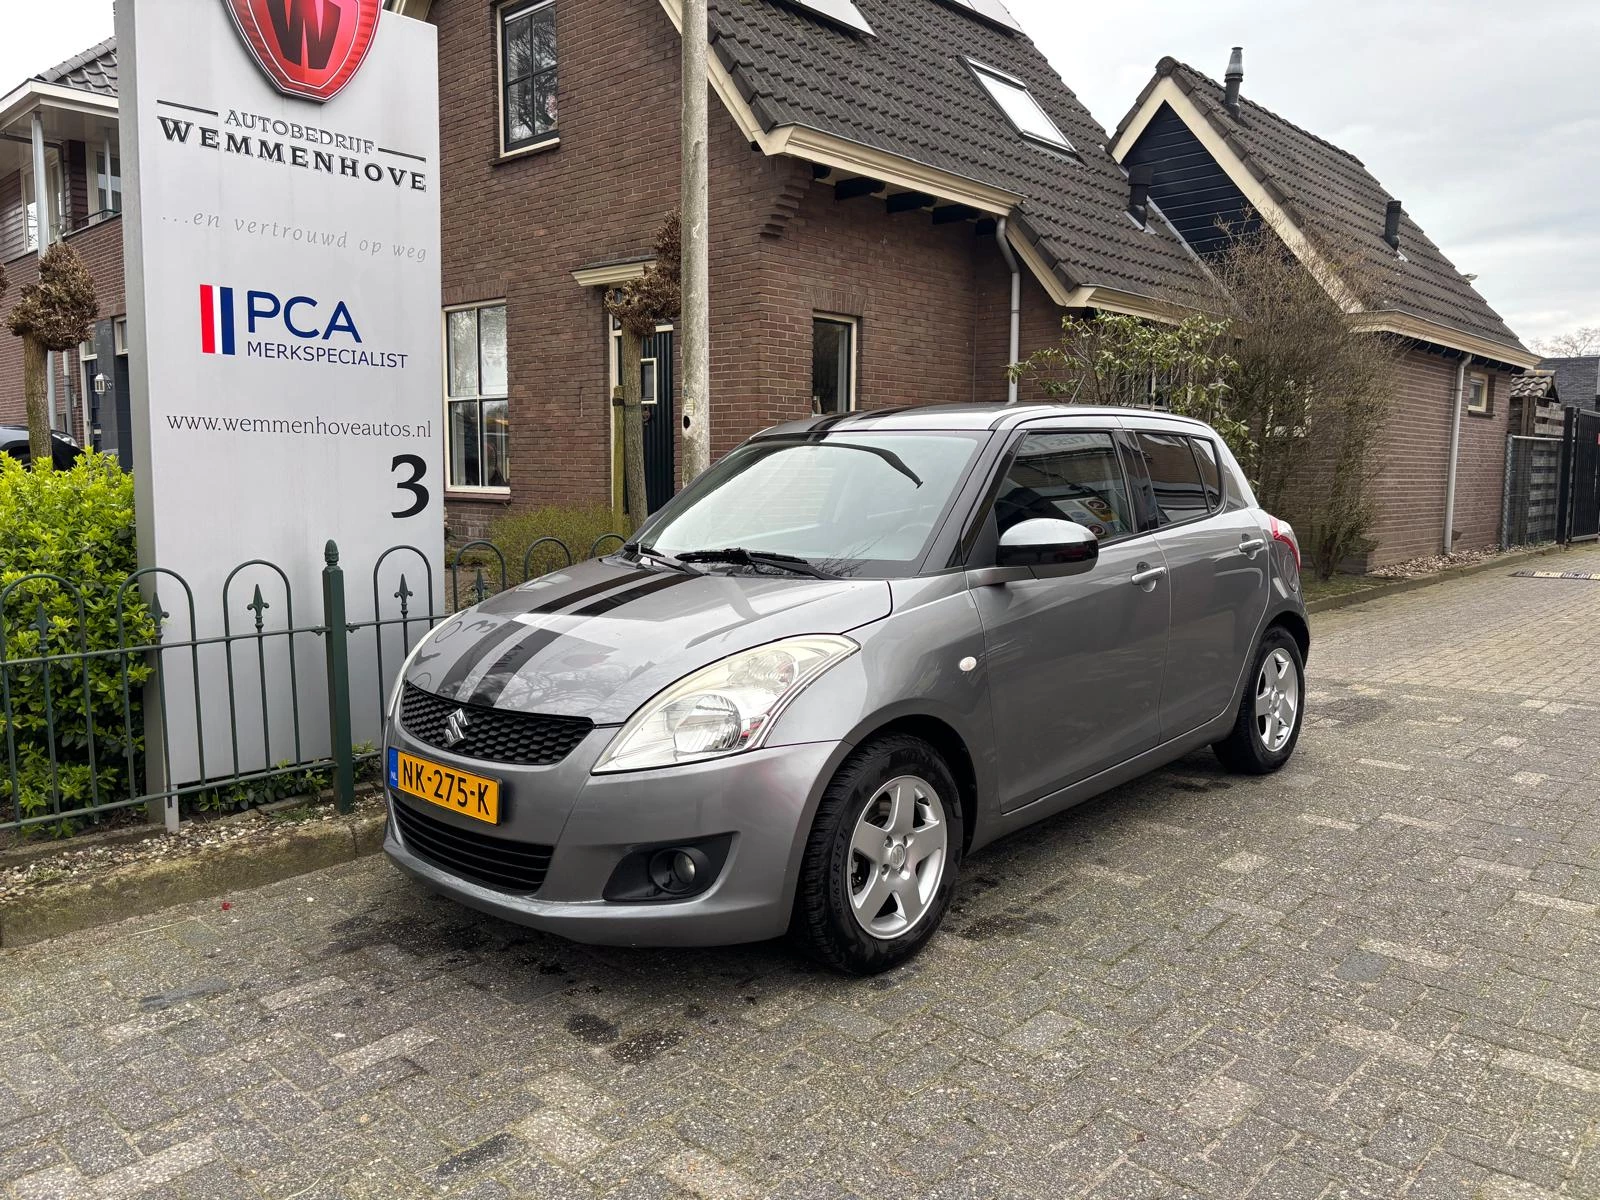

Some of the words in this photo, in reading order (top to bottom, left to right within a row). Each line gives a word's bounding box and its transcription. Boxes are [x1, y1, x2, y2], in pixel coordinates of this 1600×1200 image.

[156, 115, 427, 192] WEMMENHOVE
[224, 109, 375, 154] AUTOBEDRIJF
[235, 217, 348, 249] vertrouwd
[359, 239, 382, 256] op
[392, 243, 428, 263] weg
[247, 290, 363, 343] PCA
[247, 340, 409, 369] MERKSPECIALIST
[166, 415, 432, 438] www.wemmenhoveautos.nl
[390, 453, 430, 518] 3
[403, 757, 490, 816] NK-275-K
